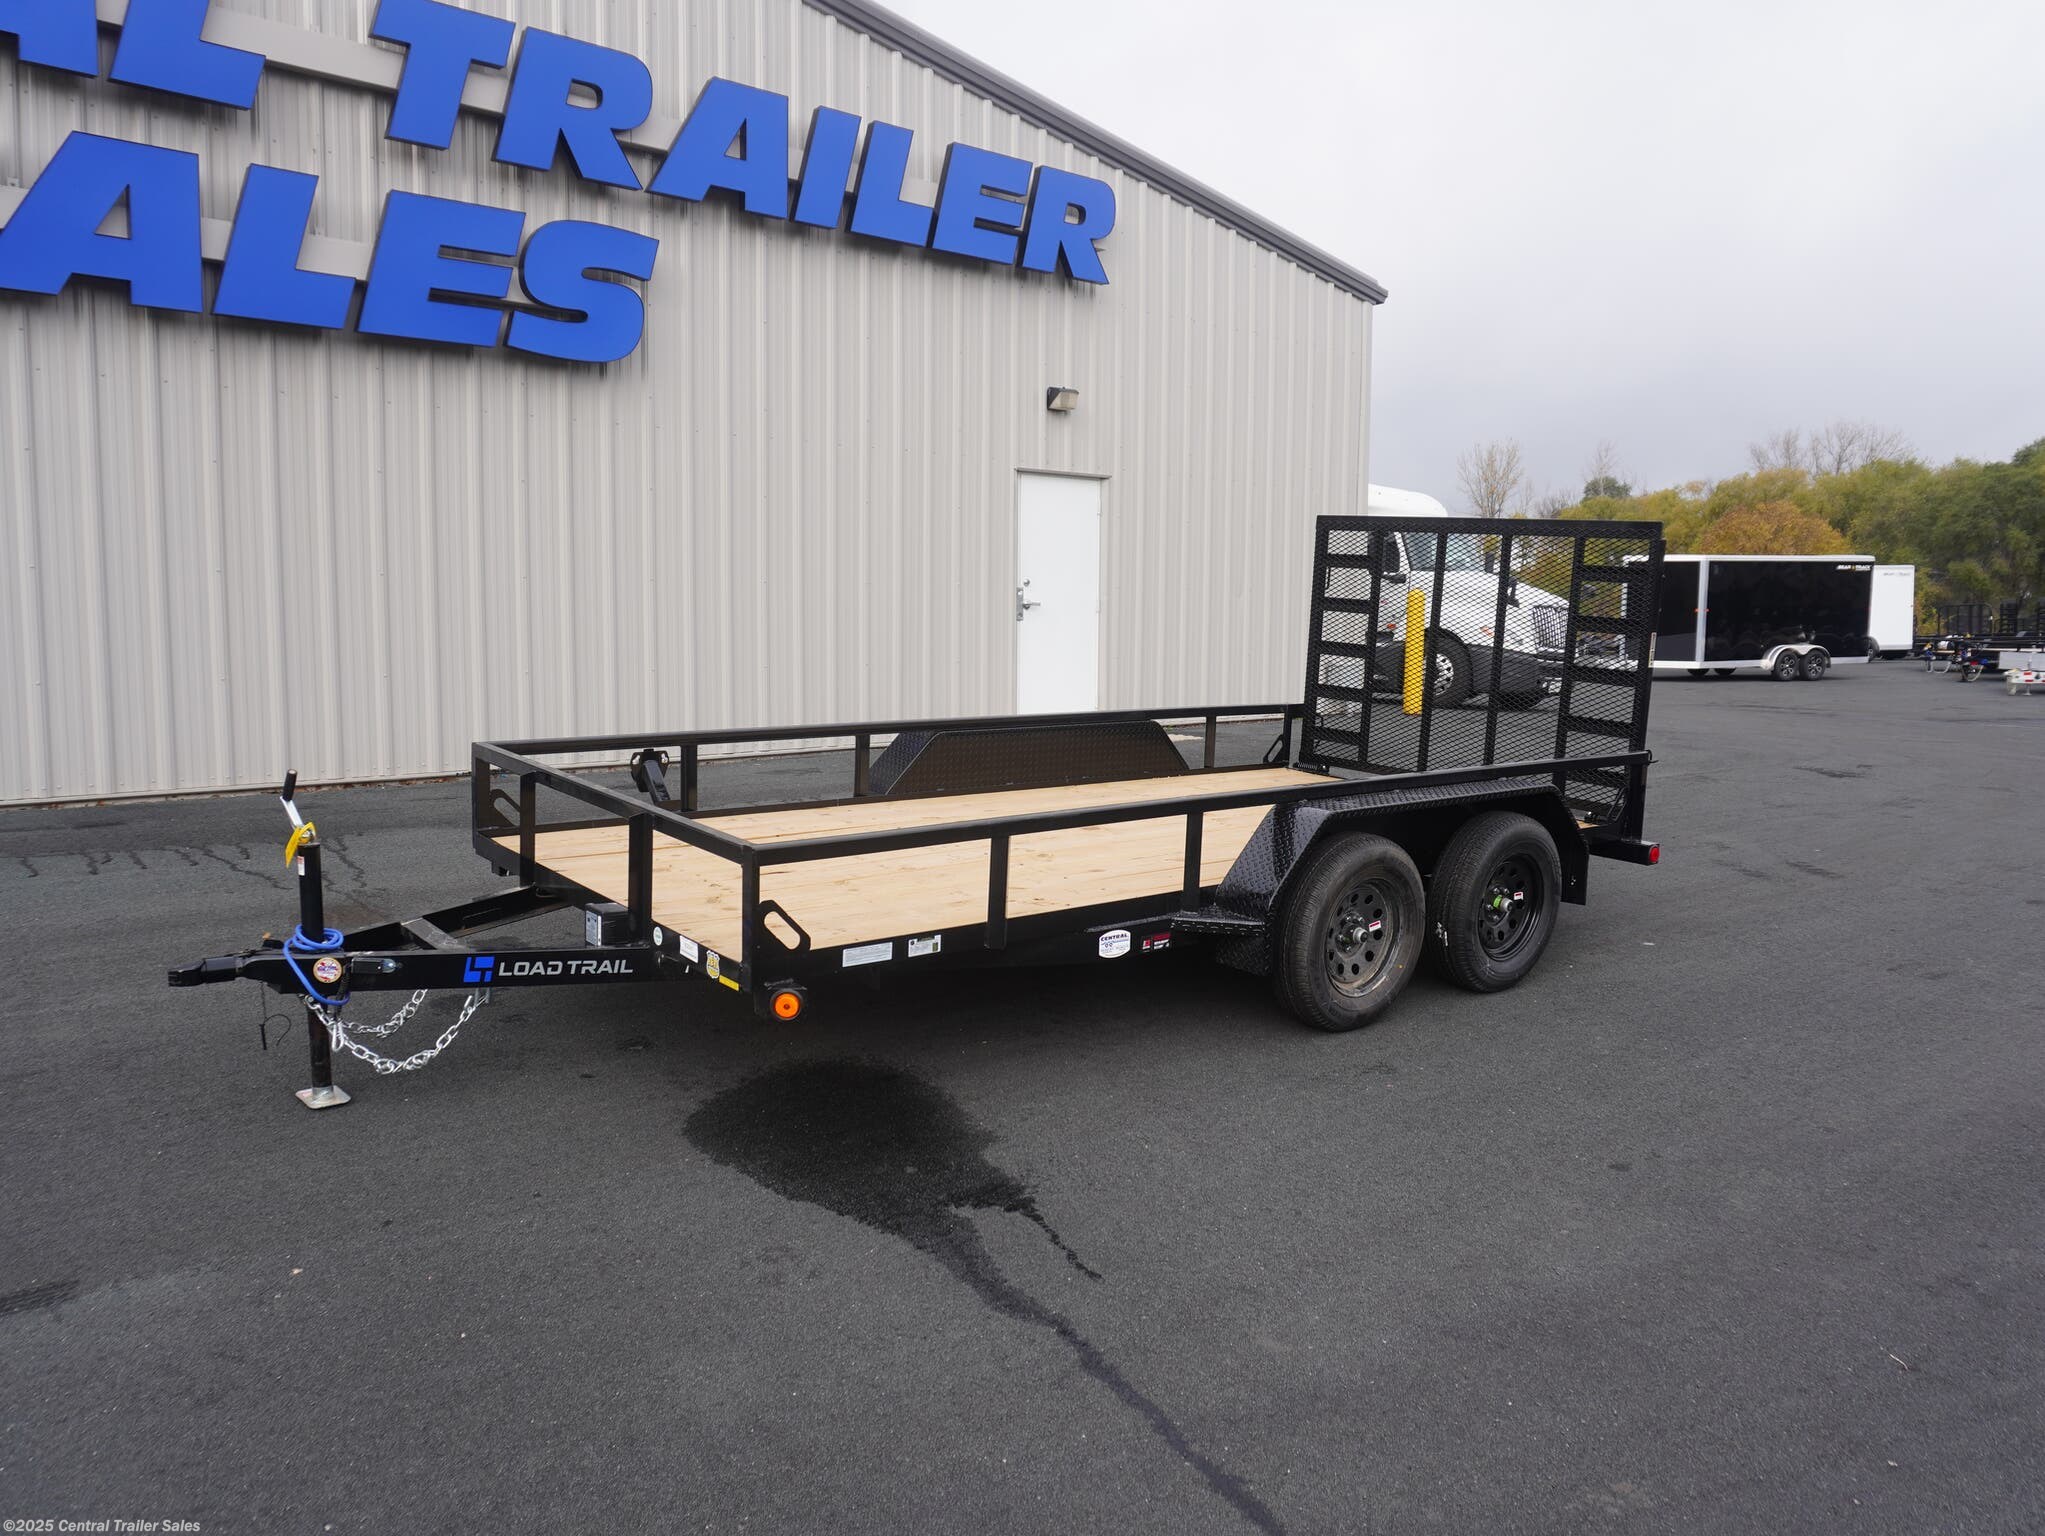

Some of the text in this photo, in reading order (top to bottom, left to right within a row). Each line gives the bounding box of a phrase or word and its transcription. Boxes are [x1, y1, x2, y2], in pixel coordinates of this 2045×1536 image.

[369, 0, 1116, 284] TRAILER
[0, 130, 660, 363] ALES
[498, 961, 563, 977] LOAD
[567, 959, 634, 975] TRAIL
[1100, 933, 1128, 942] CENTRAL
